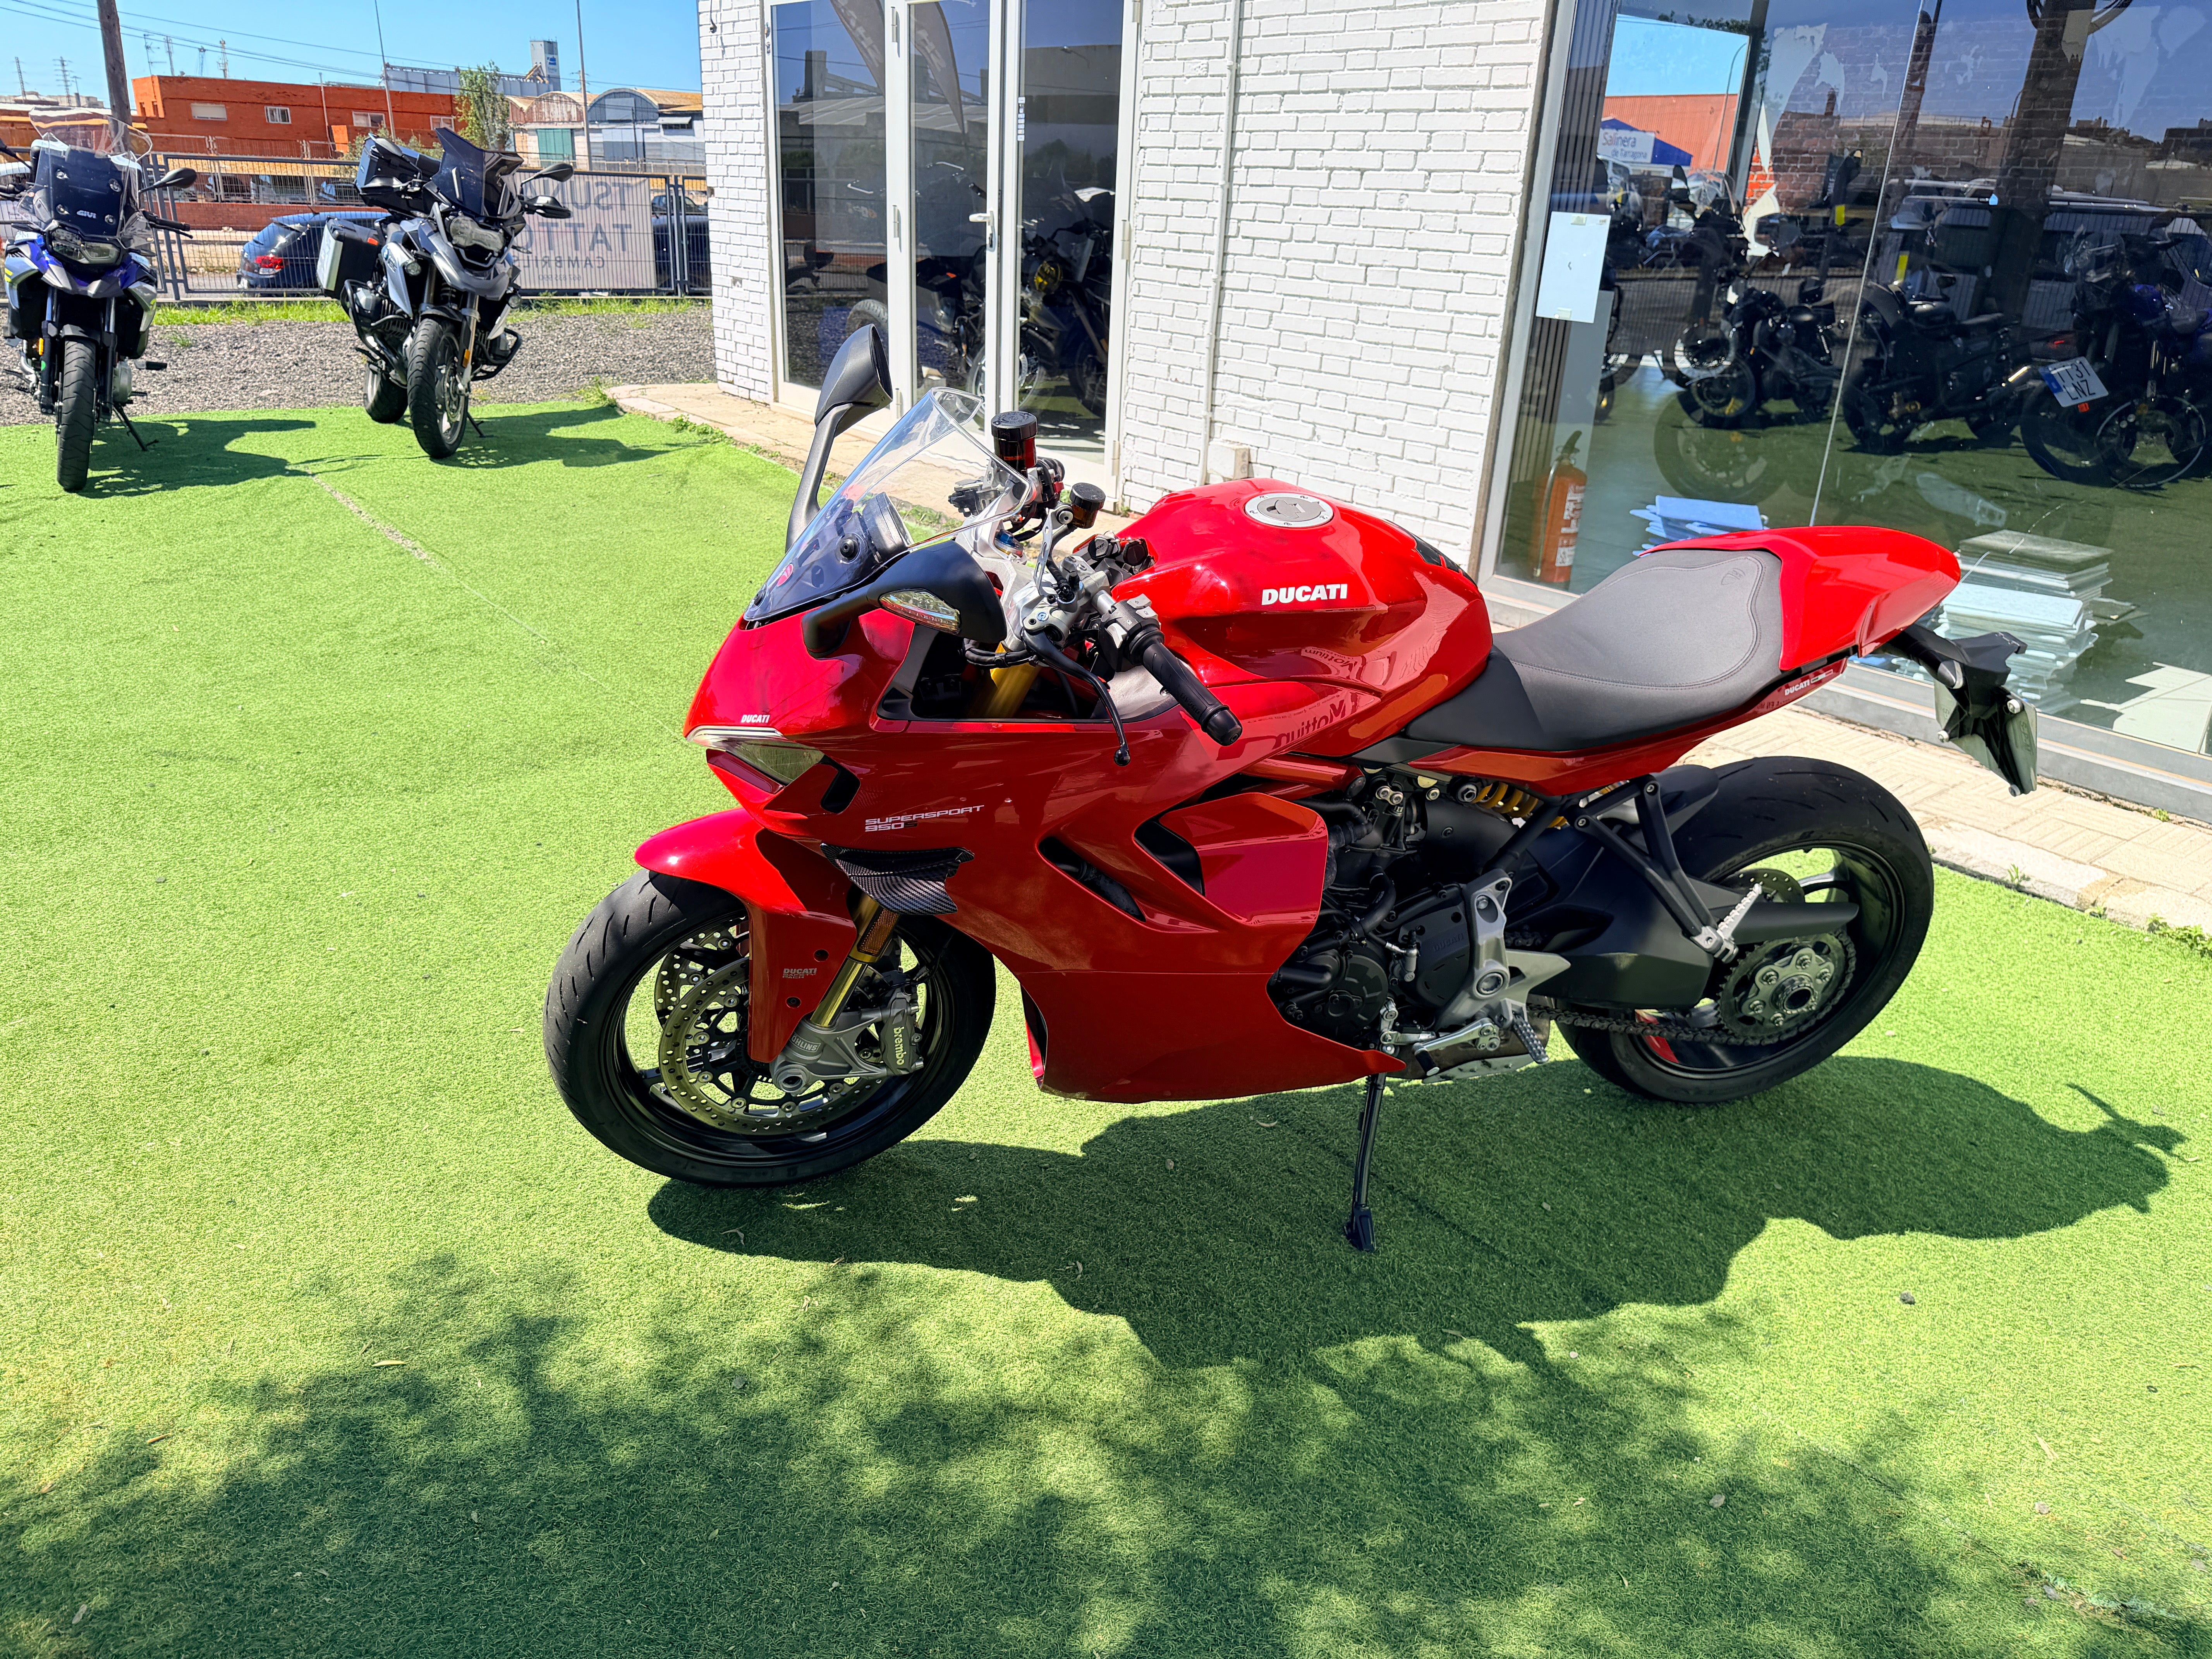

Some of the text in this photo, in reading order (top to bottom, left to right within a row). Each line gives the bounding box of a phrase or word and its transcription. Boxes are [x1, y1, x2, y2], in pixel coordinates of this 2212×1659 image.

[1602, 132, 1636, 148] Salinera
[77, 210, 96, 219] GIVI
[2054, 361, 2090, 383] 1131
[2063, 379, 2096, 400] LNZ
[1261, 584, 1348, 606] DUCATI
[1784, 679, 1810, 696] DUCATI
[740, 714, 770, 723] DUCATI
[865, 805, 984, 825] SUPERSPORT
[791, 1034, 817, 1051] ÖHLINS
[893, 1026, 905, 1065] brembo
